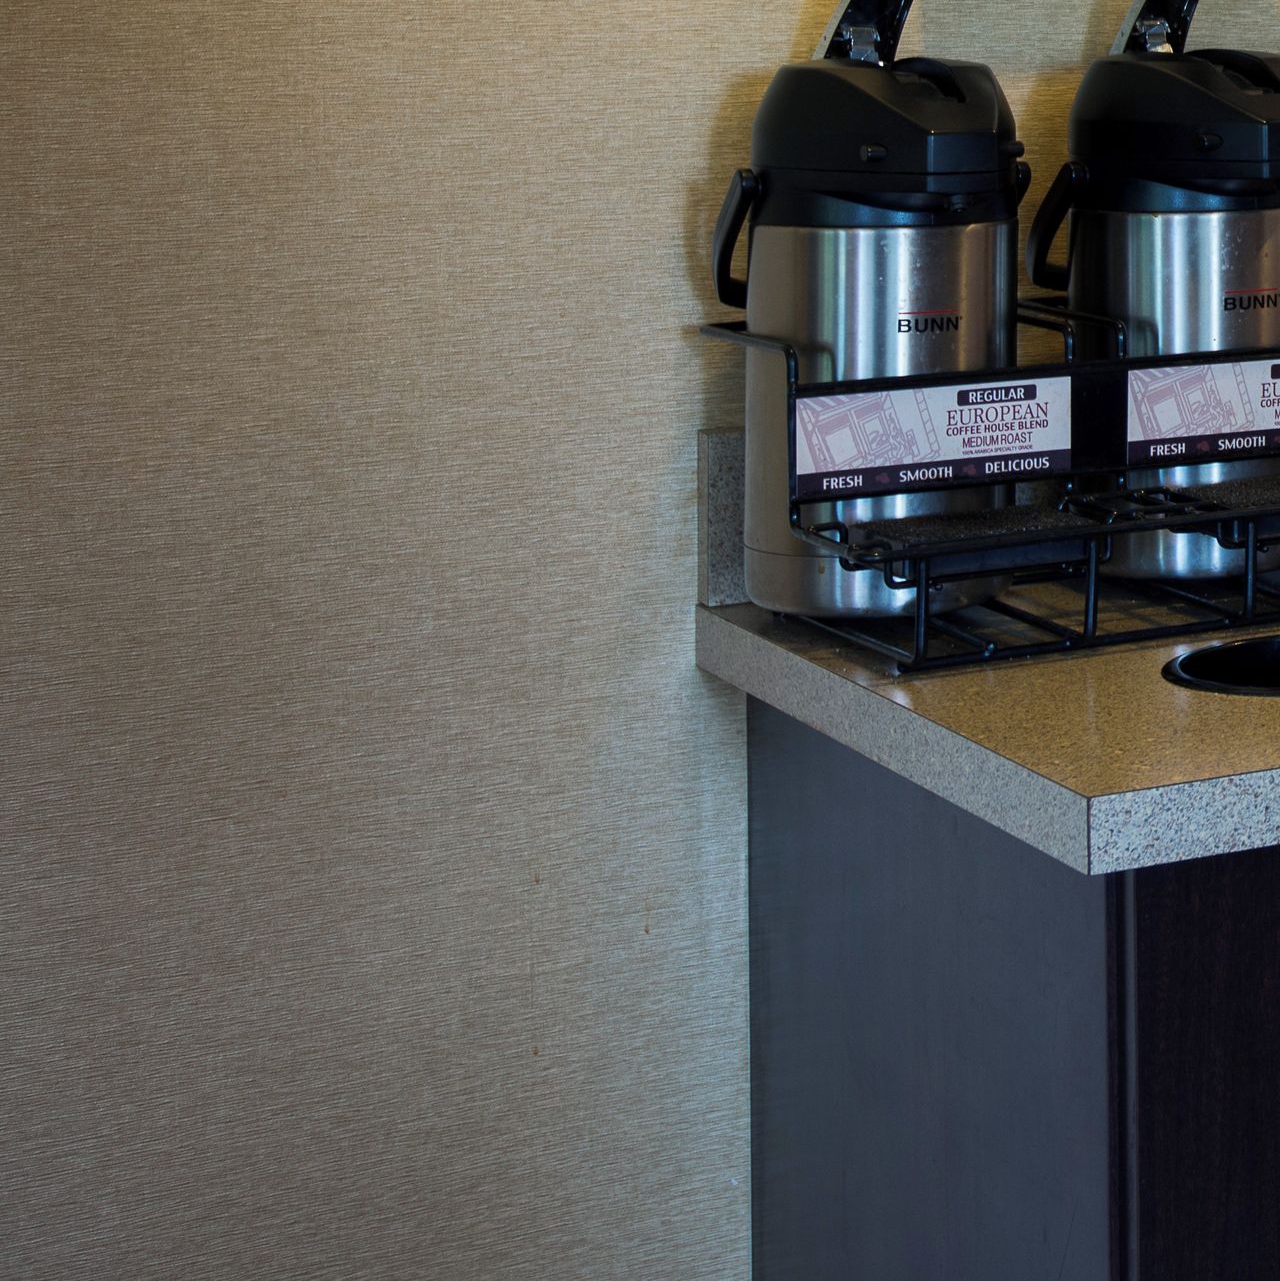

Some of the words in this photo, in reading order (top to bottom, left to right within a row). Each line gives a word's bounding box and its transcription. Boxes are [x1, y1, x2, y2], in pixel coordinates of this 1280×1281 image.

[1224, 294, 1278, 311] BUNN
[898, 316, 960, 333] BUNN
[969, 388, 1025, 403] REGULAR
[946, 402, 1049, 427] EUROPEAN
[946, 425, 981, 437] COFFEE
[984, 421, 1016, 433] HOUSE
[1018, 419, 1049, 430] BLEND
[962, 434, 999, 449] MEDIUM
[1000, 431, 1033, 445] ROAST
[1150, 443, 1186, 457] FRESH
[1218, 435, 1266, 451] SMOOTH
[823, 475, 863, 490] FRESH
[900, 466, 953, 483] SMOOTH
[985, 457, 1050, 474] DELICIOUS
